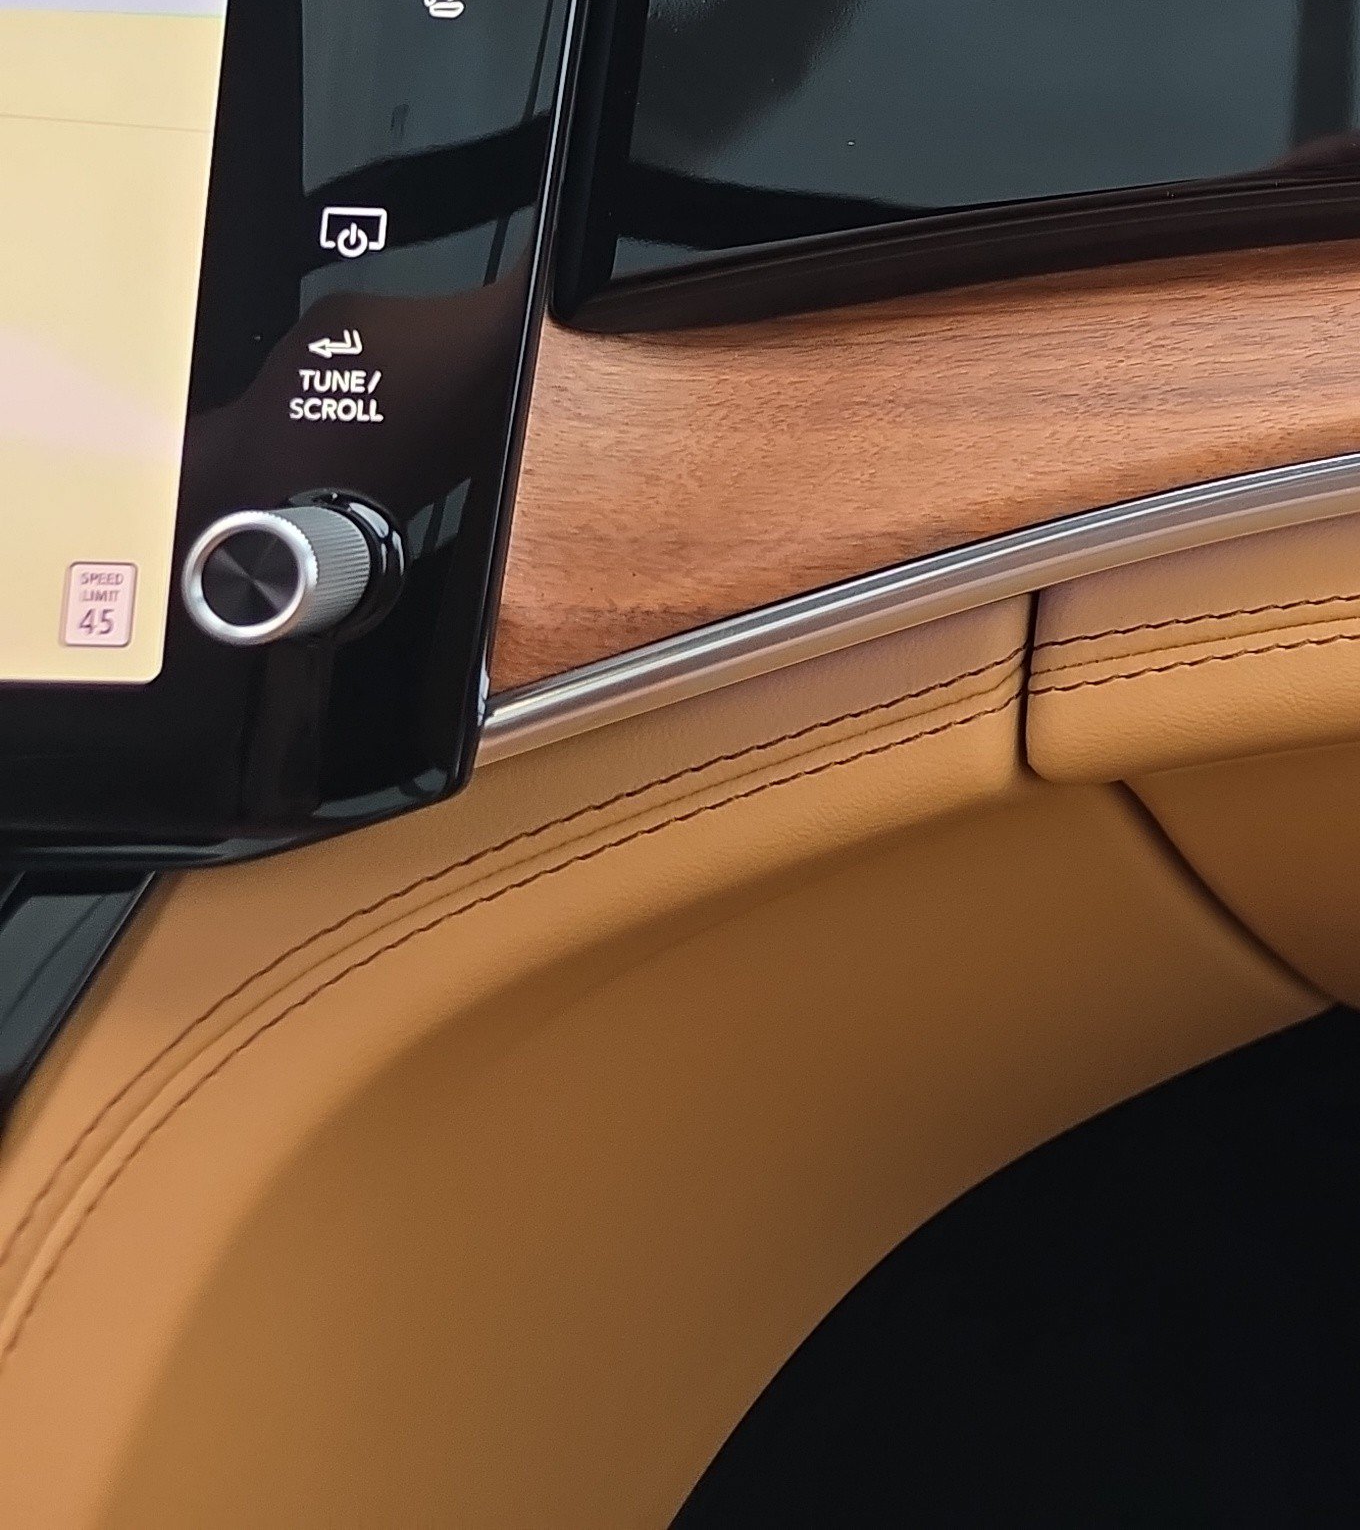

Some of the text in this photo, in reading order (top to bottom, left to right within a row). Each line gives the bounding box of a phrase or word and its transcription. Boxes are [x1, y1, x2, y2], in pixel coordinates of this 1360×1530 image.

[299, 369, 382, 395] TUNE/
[289, 397, 384, 422] SCROLL
[81, 572, 124, 585] SPEED
[81, 590, 120, 602] LIMIT
[79, 608, 114, 635] 45
